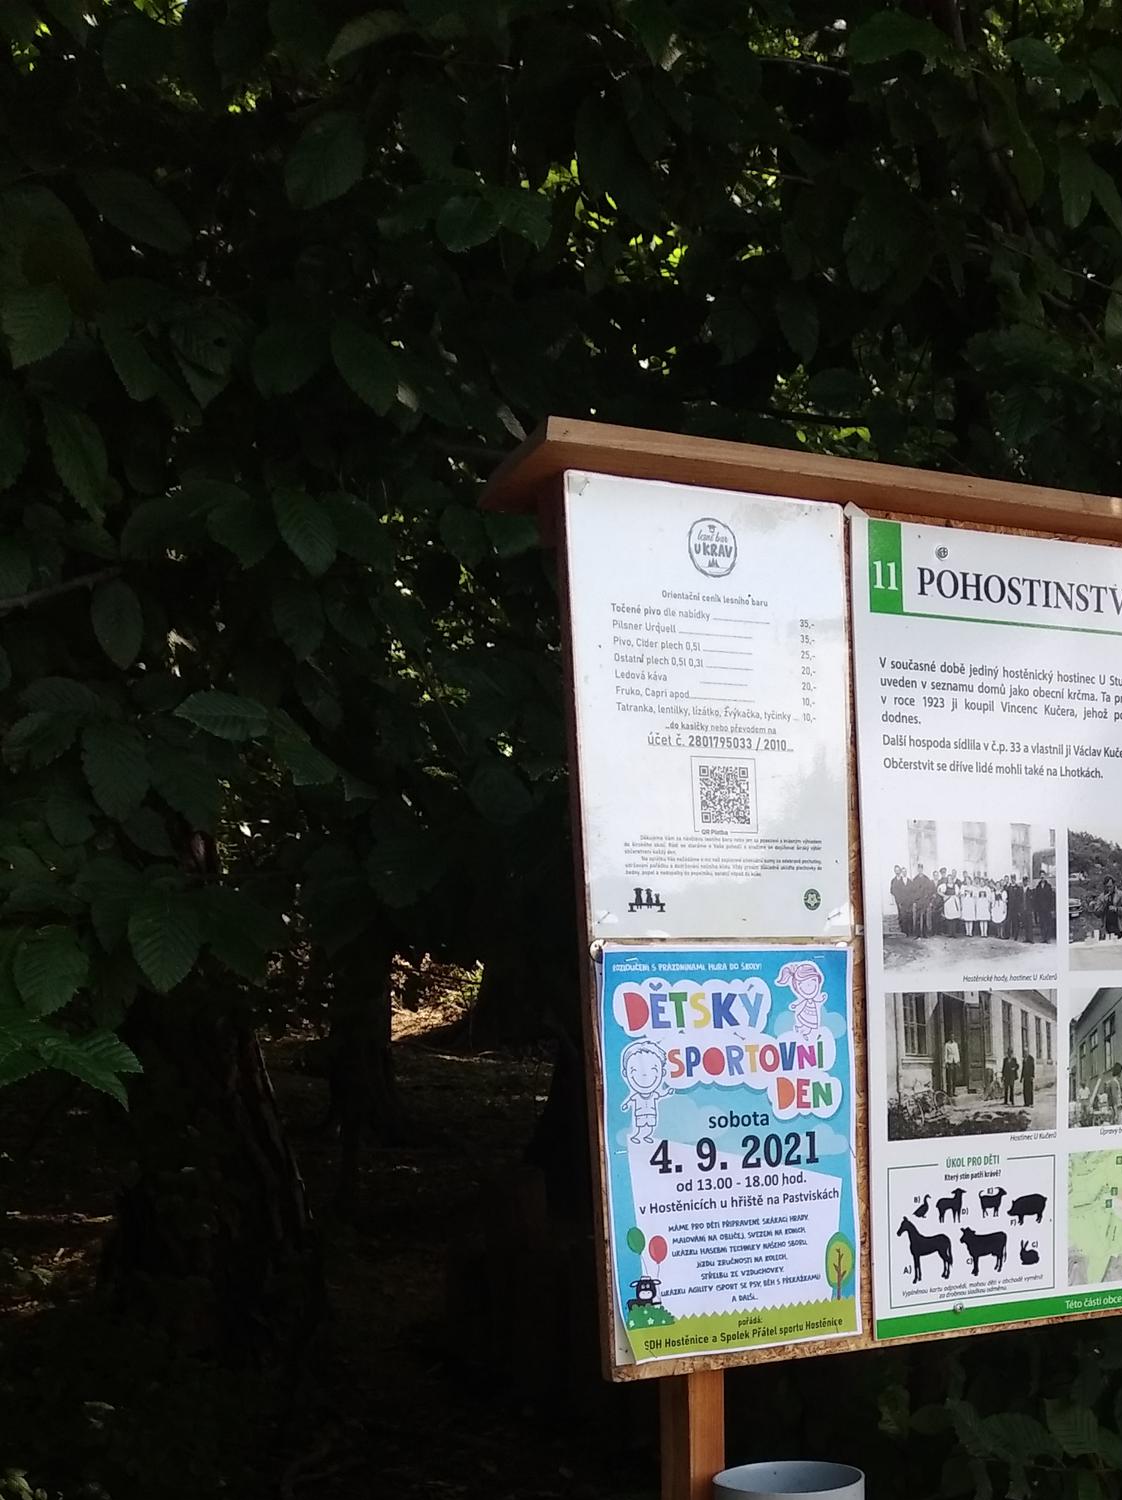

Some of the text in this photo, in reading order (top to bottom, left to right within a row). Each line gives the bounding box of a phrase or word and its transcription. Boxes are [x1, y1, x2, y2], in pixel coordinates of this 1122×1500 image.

[694, 543, 733, 558] U KRAV
[873, 560, 898, 591] 11
[662, 590, 768, 606] Orientační ceník lesního baru
[611, 603, 641, 614] Točené
[644, 607, 661, 617] pivo
[664, 608, 676, 617] dle
[679, 609, 710, 621] nabídky
[612, 620, 642, 630] Pilsner
[645, 622, 676, 633] Urquell
[613, 636, 633, 647] Pivo,
[636, 638, 657, 648] Cider
[661, 641, 683, 651] plech
[614, 653, 644, 663] Ostatní
[646, 655, 669, 666] plech
[615, 669, 645, 680] Ledová
[648, 672, 667, 681] káva
[879, 657, 886, 668] V
[890, 659, 936, 672] současné
[940, 662, 965, 674] době
[969, 664, 998, 679] jediný
[1003, 667, 1053, 684] hostěnický
[1057, 671, 1095, 684] hostinec
[1099, 675, 1105, 685] U
[615, 686, 643, 697] Fruko,
[645, 688, 667, 699] Capri
[880, 676, 917, 688] uveden
[921, 680, 927, 688] v
[931, 681, 973, 692] seznamu
[978, 682, 1005, 695] domů
[1009, 686, 1029, 698] jako
[1033, 686, 1064, 699] obecní
[1068, 689, 1097, 701] krčma.
[1101, 692, 1110, 702] Ta
[616, 702, 656, 713] Tatranka,
[658, 705, 690, 716] lentilky,
[692, 706, 721, 717] lízátko,
[764, 710, 791, 721] tyčinky
[881, 696, 887, 704] v
[894, 696, 915, 706] roce
[923, 696, 944, 708] 1923
[951, 698, 957, 711] ji
[965, 698, 994, 714] koupil
[1001, 701, 1038, 714] Vincenc
[1044, 705, 1077, 718] Kučera,
[1083, 707, 1108, 720] jehož
[882, 711, 921, 724] dodnes.
[648, 732, 672, 745] účet
[676, 733, 684, 747] č.
[688, 735, 752, 749] 2801795033
[882, 734, 906, 746] Další
[909, 736, 950, 750] hospoda
[954, 738, 981, 750] sídlila
[984, 742, 989, 750] v
[991, 741, 1008, 754] č.p.
[1010, 742, 1021, 752] 33
[1023, 745, 1029, 753] a
[1031, 743, 1063, 755] vlastnil
[1065, 745, 1071, 757] ji
[1073, 745, 1101, 757] Václav
[883, 757, 1103, 779] Občerstvit se dříve lidé mohli také na Lhotkách.
[623, 982, 763, 1031] DĚTSKÝ
[668, 1034, 823, 1078] SPORTOVNÍ
[776, 1077, 833, 1110] DEN
[709, 1111, 769, 1128] sobota
[650, 1131, 819, 1174] 4. 9. 2021
[946, 1154, 1000, 1168] ÚKOL PRO DĚTI
[677, 1179, 692, 1192] od
[697, 1178, 733, 1191] 13.00
[745, 1175, 778, 1188] 18.00
[782, 1172, 807, 1186] hod.
[944, 1173, 958, 1182] Který
[971, 1172, 983, 1180] patří
[984, 1170, 1001, 1178] krávě?
[639, 1189, 839, 1215] v Hostěnicích u hřiště na Pastviskách
[1065, 1300, 1082, 1309] Této
[1084, 1298, 1101, 1307] části
[1103, 1296, 1122, 1305] obce
[738, 1317, 763, 1327] pořádá:
[644, 1318, 843, 1350] SDH Hostěnice a Spolek Přátel sportu Hostěnice
